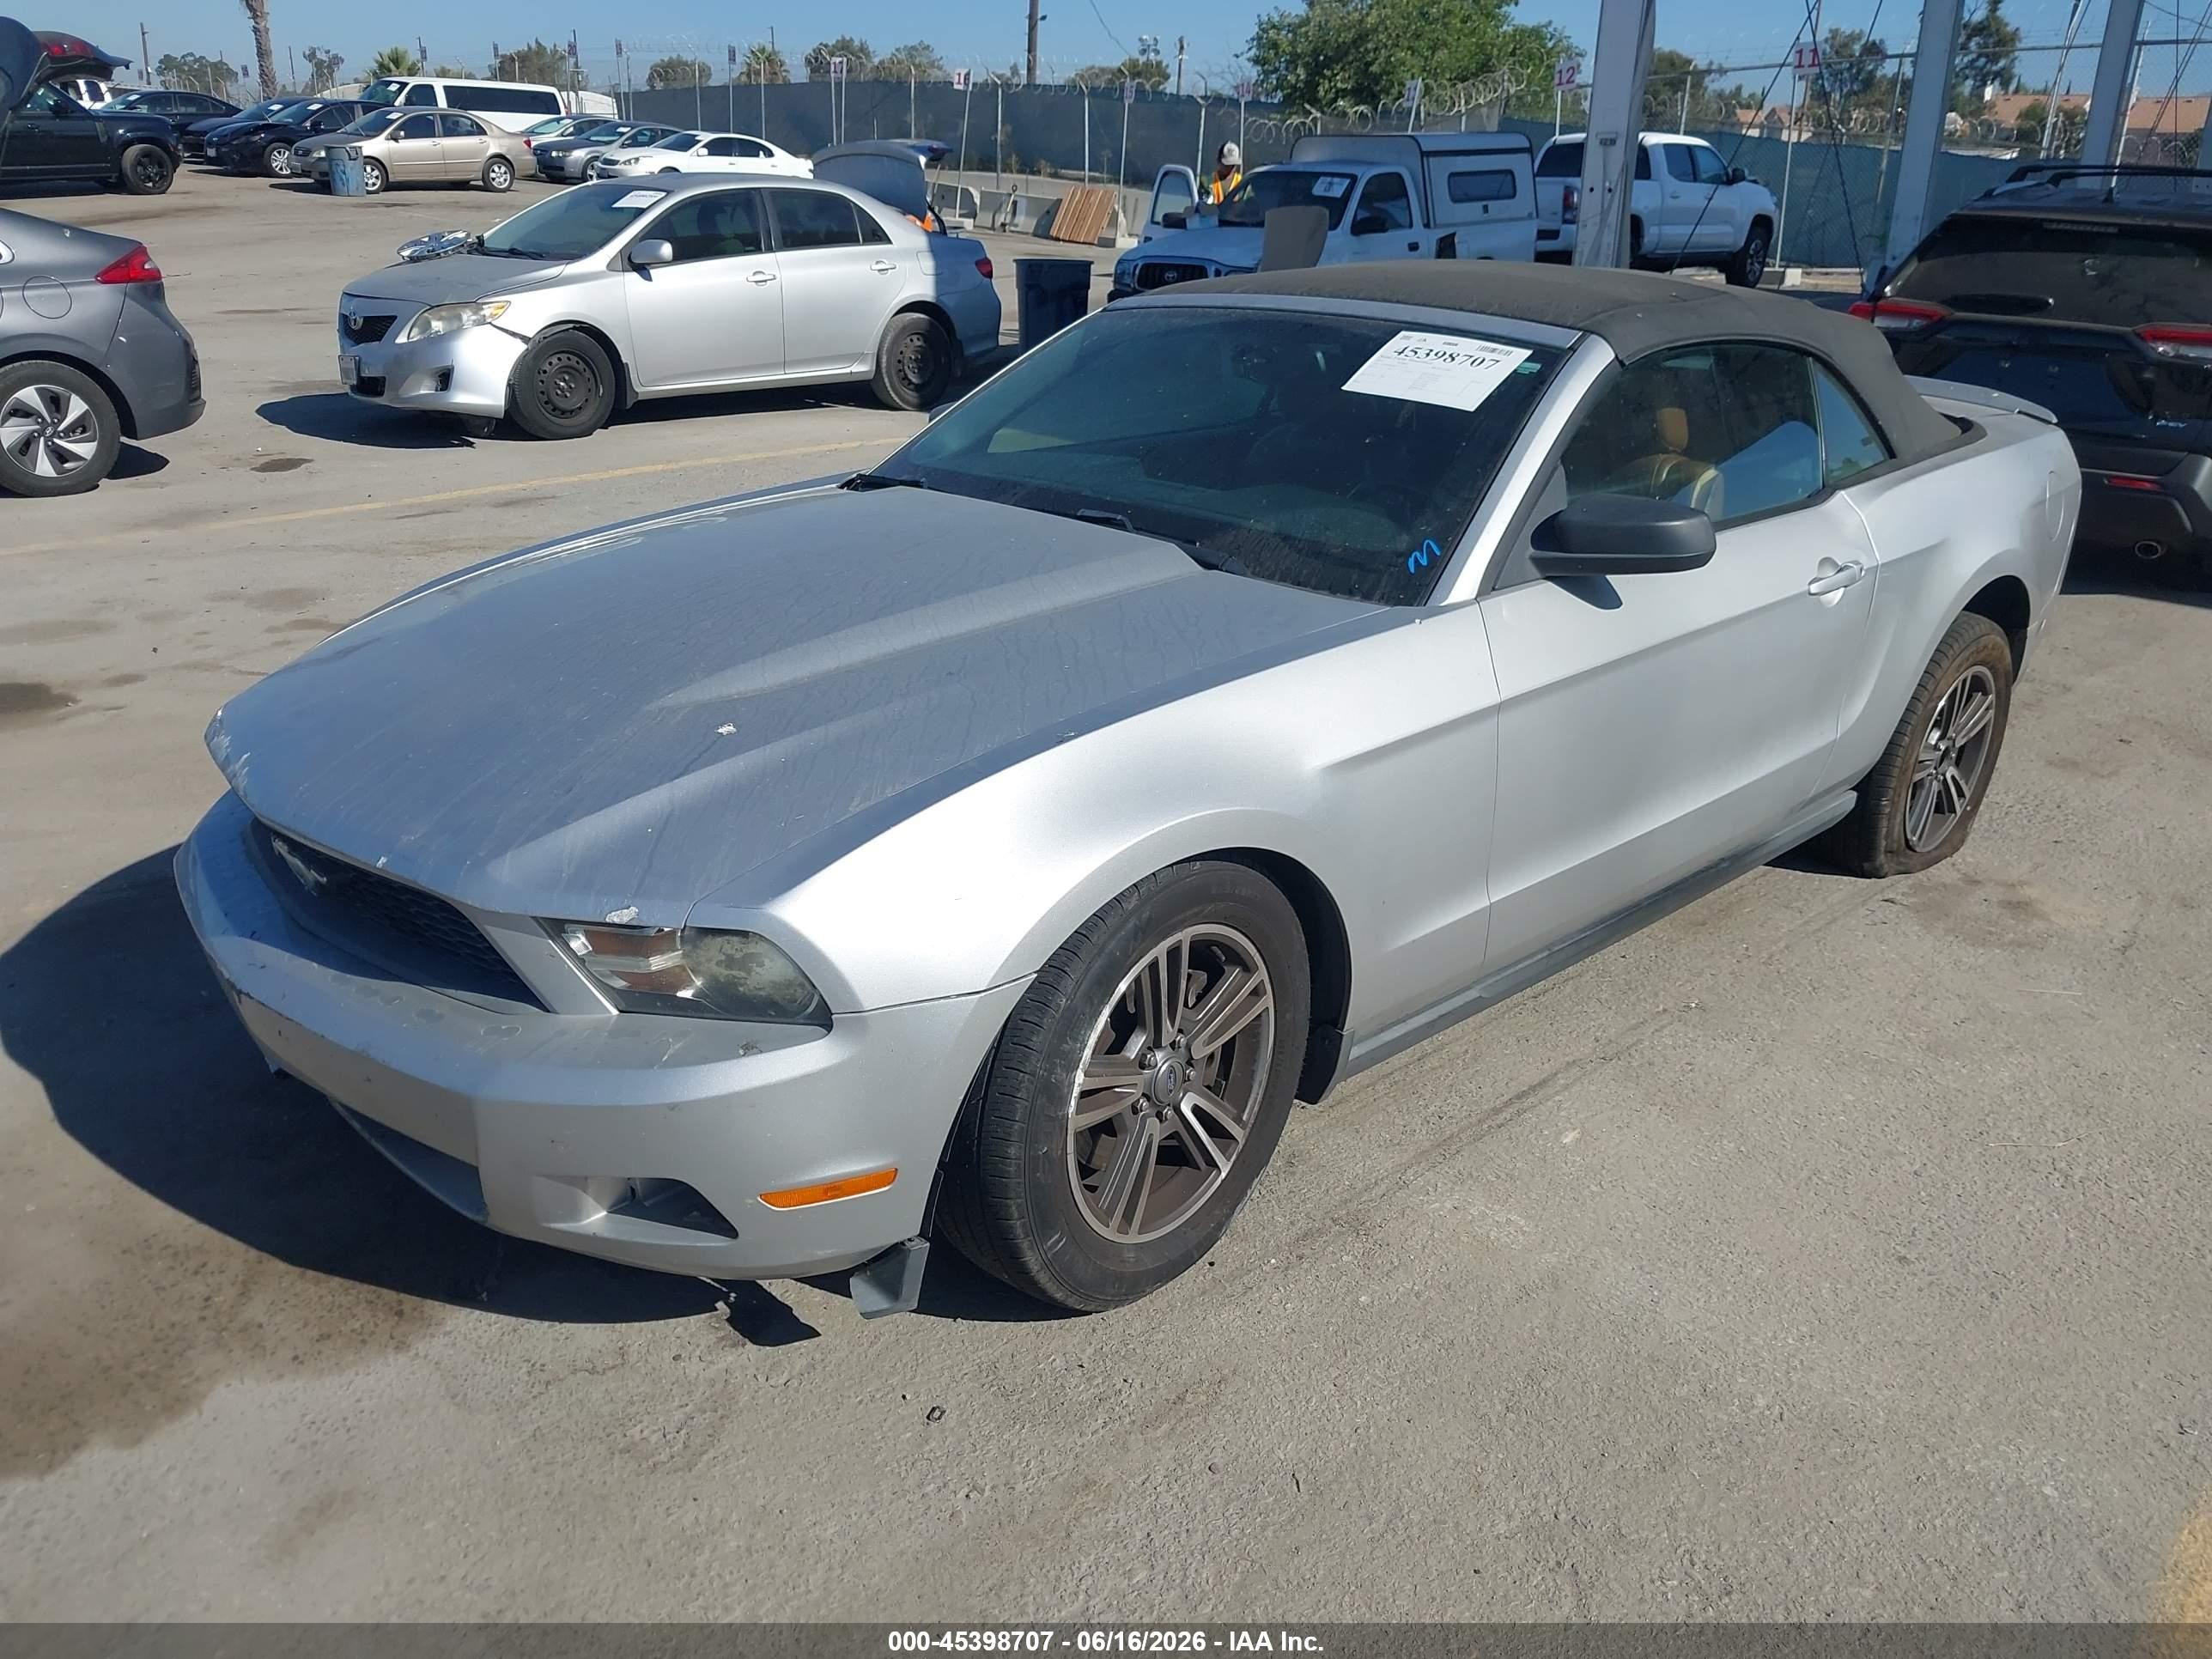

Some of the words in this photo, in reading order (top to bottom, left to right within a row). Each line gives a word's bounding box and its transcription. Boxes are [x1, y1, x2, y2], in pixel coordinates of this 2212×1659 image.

[1794, 48, 1820, 69] 11
[1556, 66, 1575, 86] 12
[1394, 345, 1501, 370] 45398707
